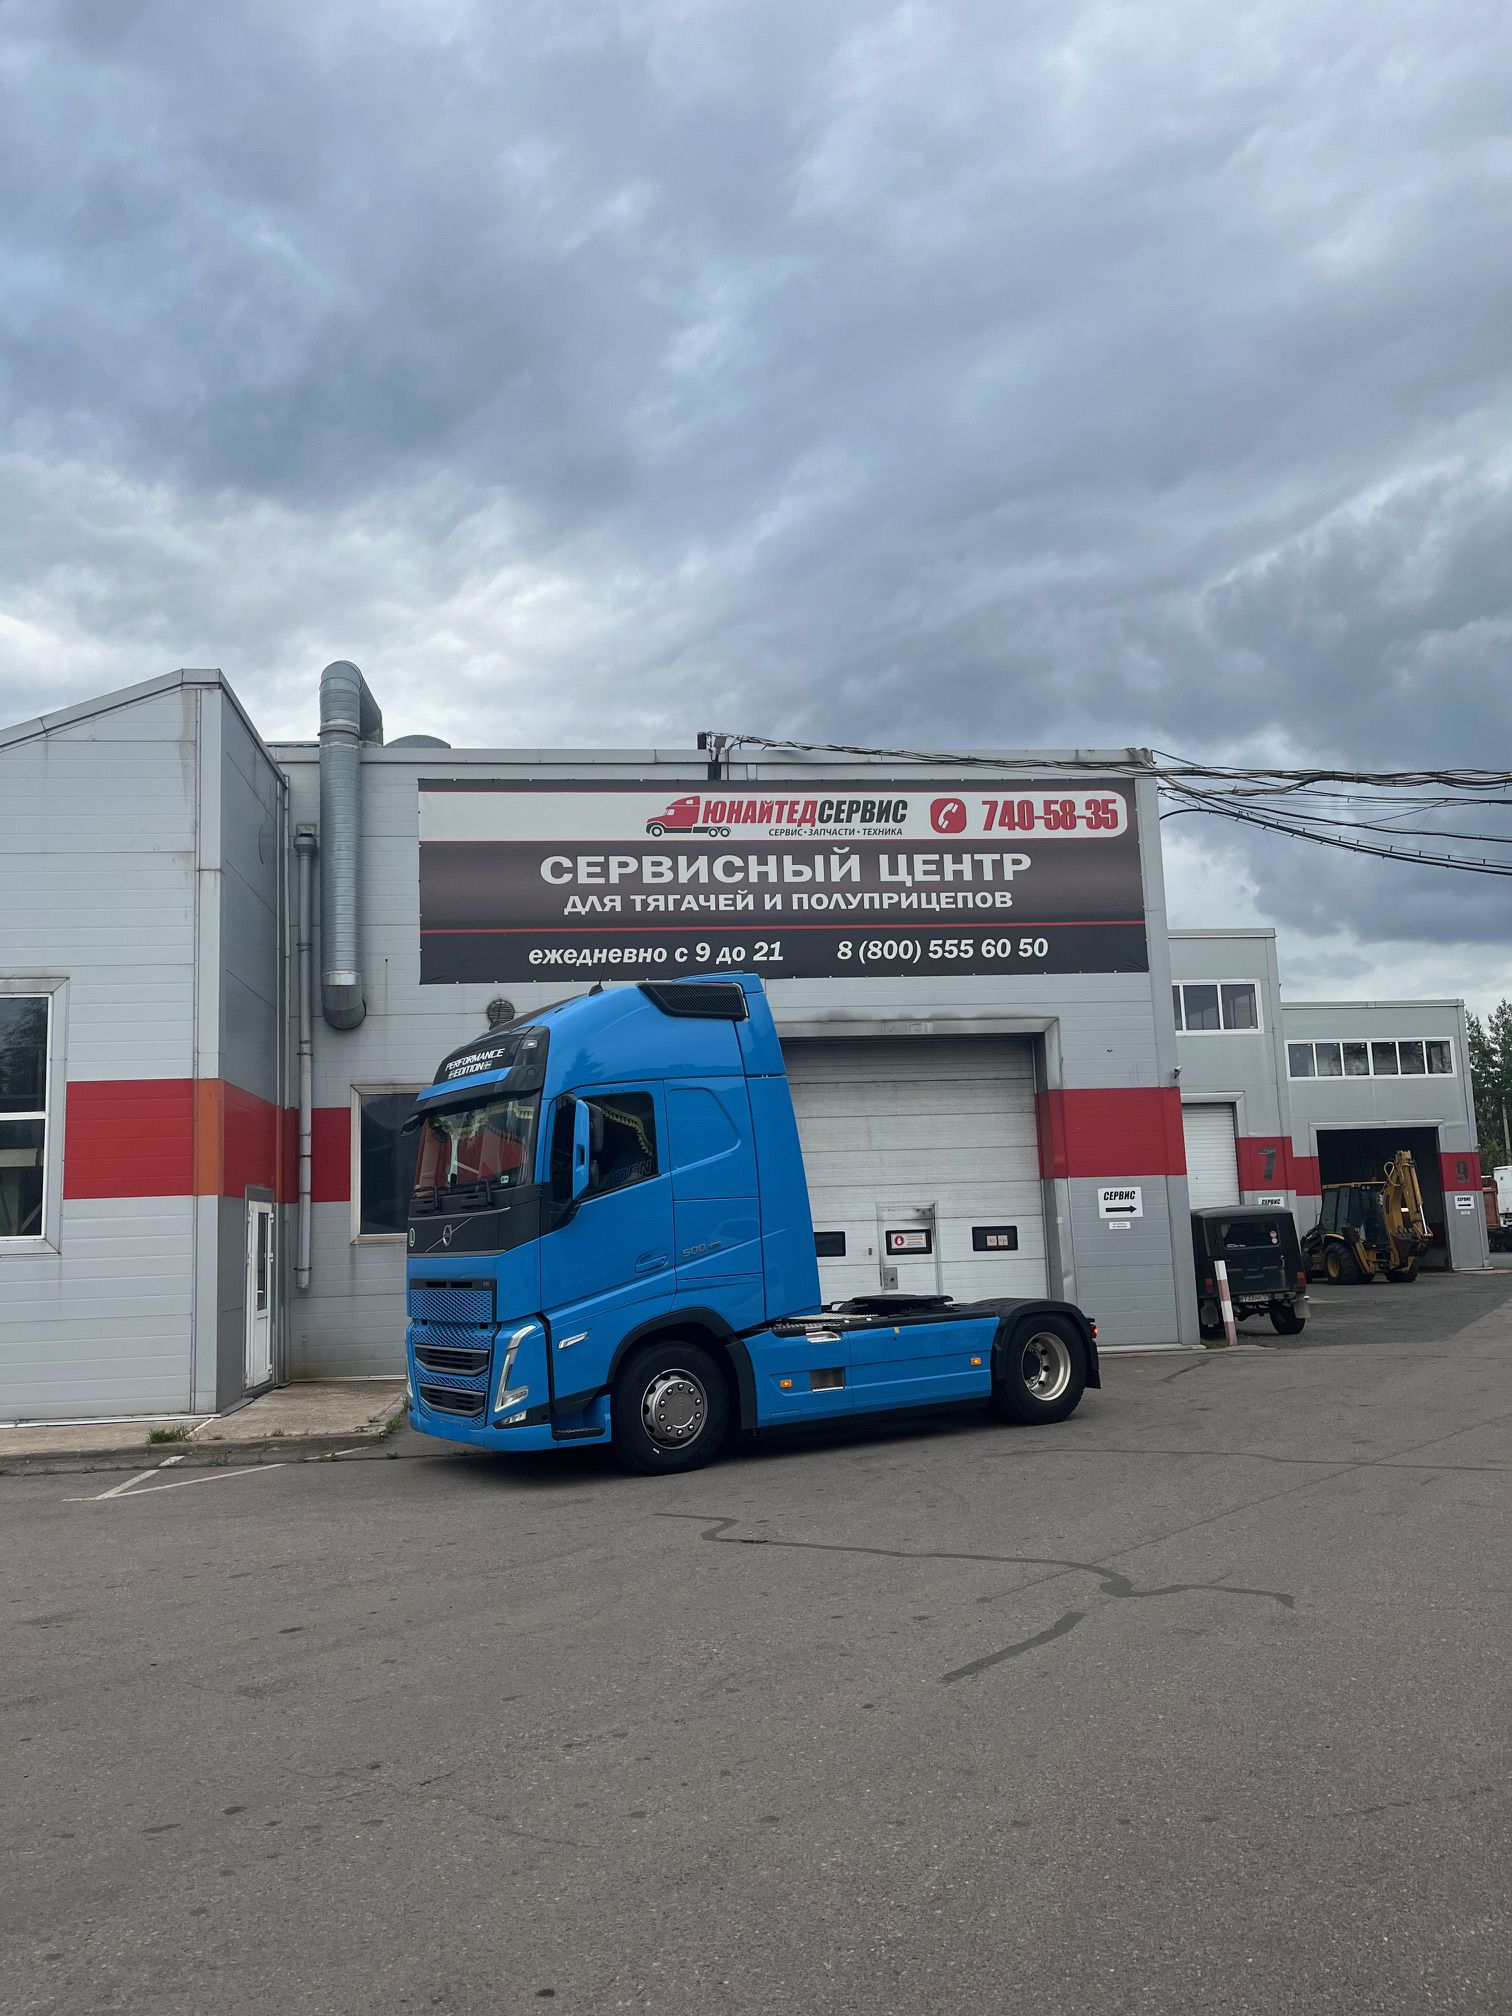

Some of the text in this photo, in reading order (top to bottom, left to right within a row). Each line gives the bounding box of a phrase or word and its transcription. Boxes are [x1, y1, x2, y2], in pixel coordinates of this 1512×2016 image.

[981, 798, 1118, 831] 740-58-35
[768, 827, 903, 837] СЕРВИС ЗАПЧАСТИ ТЕХНИКА
[540, 846, 1032, 887] СЕРВИСНЫЙ ЦЕНТР
[564, 890, 1013, 915] ДЛЯ ТЯГАЧЕЙ И ПОЛУПРИЦЕПОВ
[528, 941, 784, 967] ежедневно с 9 до 21
[837, 937, 1049, 963] 8 (800) 555 60 50
[445, 1048, 506, 1071] PERFORMANCE
[453, 1062, 485, 1078] EDITION
[1258, 1149, 1276, 1181] 7
[1103, 1190, 1136, 1201] СЕРВИС
